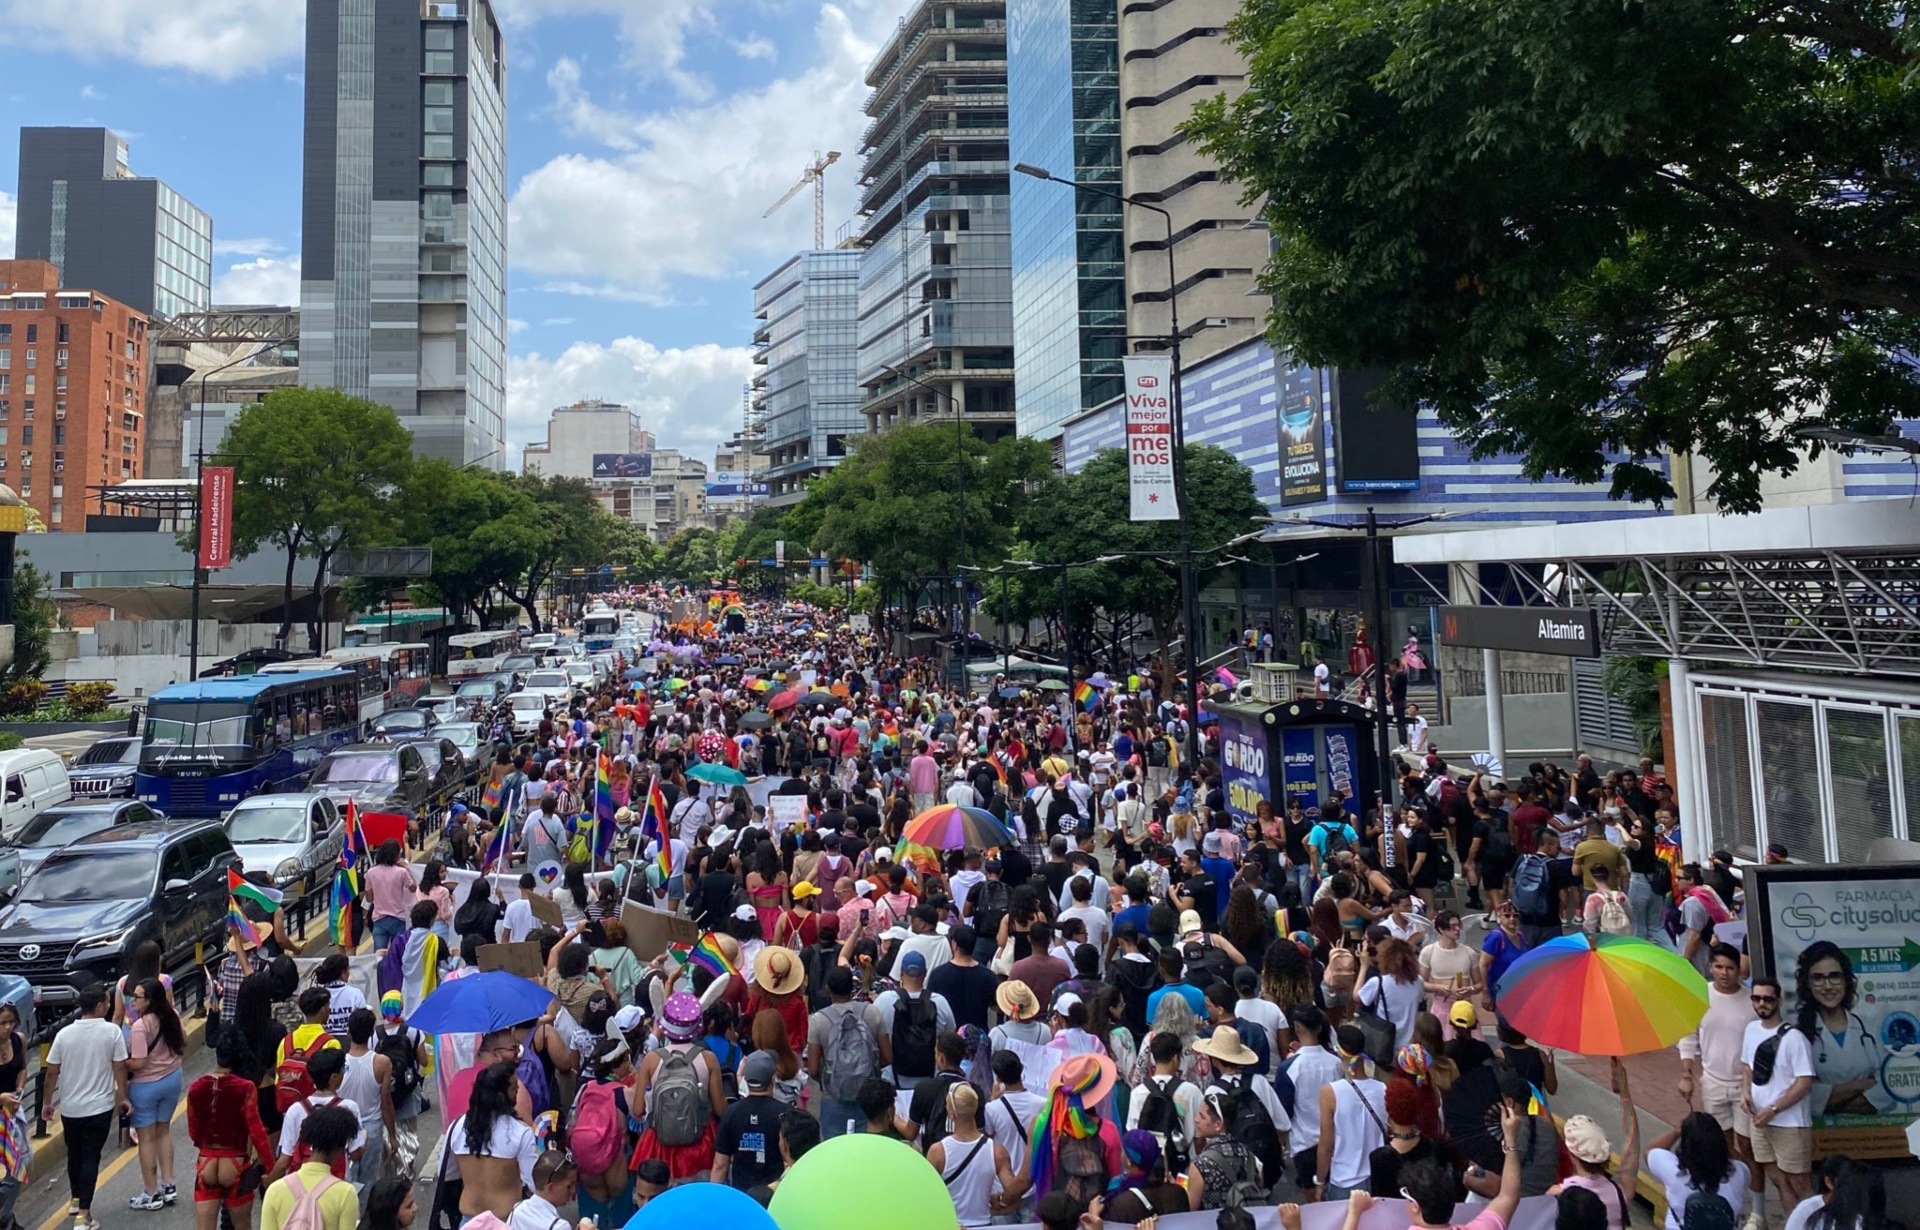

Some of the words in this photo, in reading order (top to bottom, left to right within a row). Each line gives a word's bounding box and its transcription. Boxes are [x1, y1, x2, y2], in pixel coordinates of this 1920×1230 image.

[1129, 394, 1167, 408] Viva
[1131, 410, 1167, 421] mejor
[1141, 425, 1159, 434] por
[1132, 437, 1168, 451] me
[1133, 453, 1169, 465] nos
[211, 475, 220, 526] Madeirense
[210, 526, 219, 560] Central
[1538, 618, 1585, 640] Altamira
[1224, 739, 1264, 778] GORDO
[1284, 754, 1315, 763] GORDO
[1286, 782, 1317, 791] 100.000
[1835, 890, 1914, 903] FARMACIA
[1861, 949, 1869, 962] A
[1870, 949, 1878, 962] 5
[1879, 948, 1901, 962] MTS
